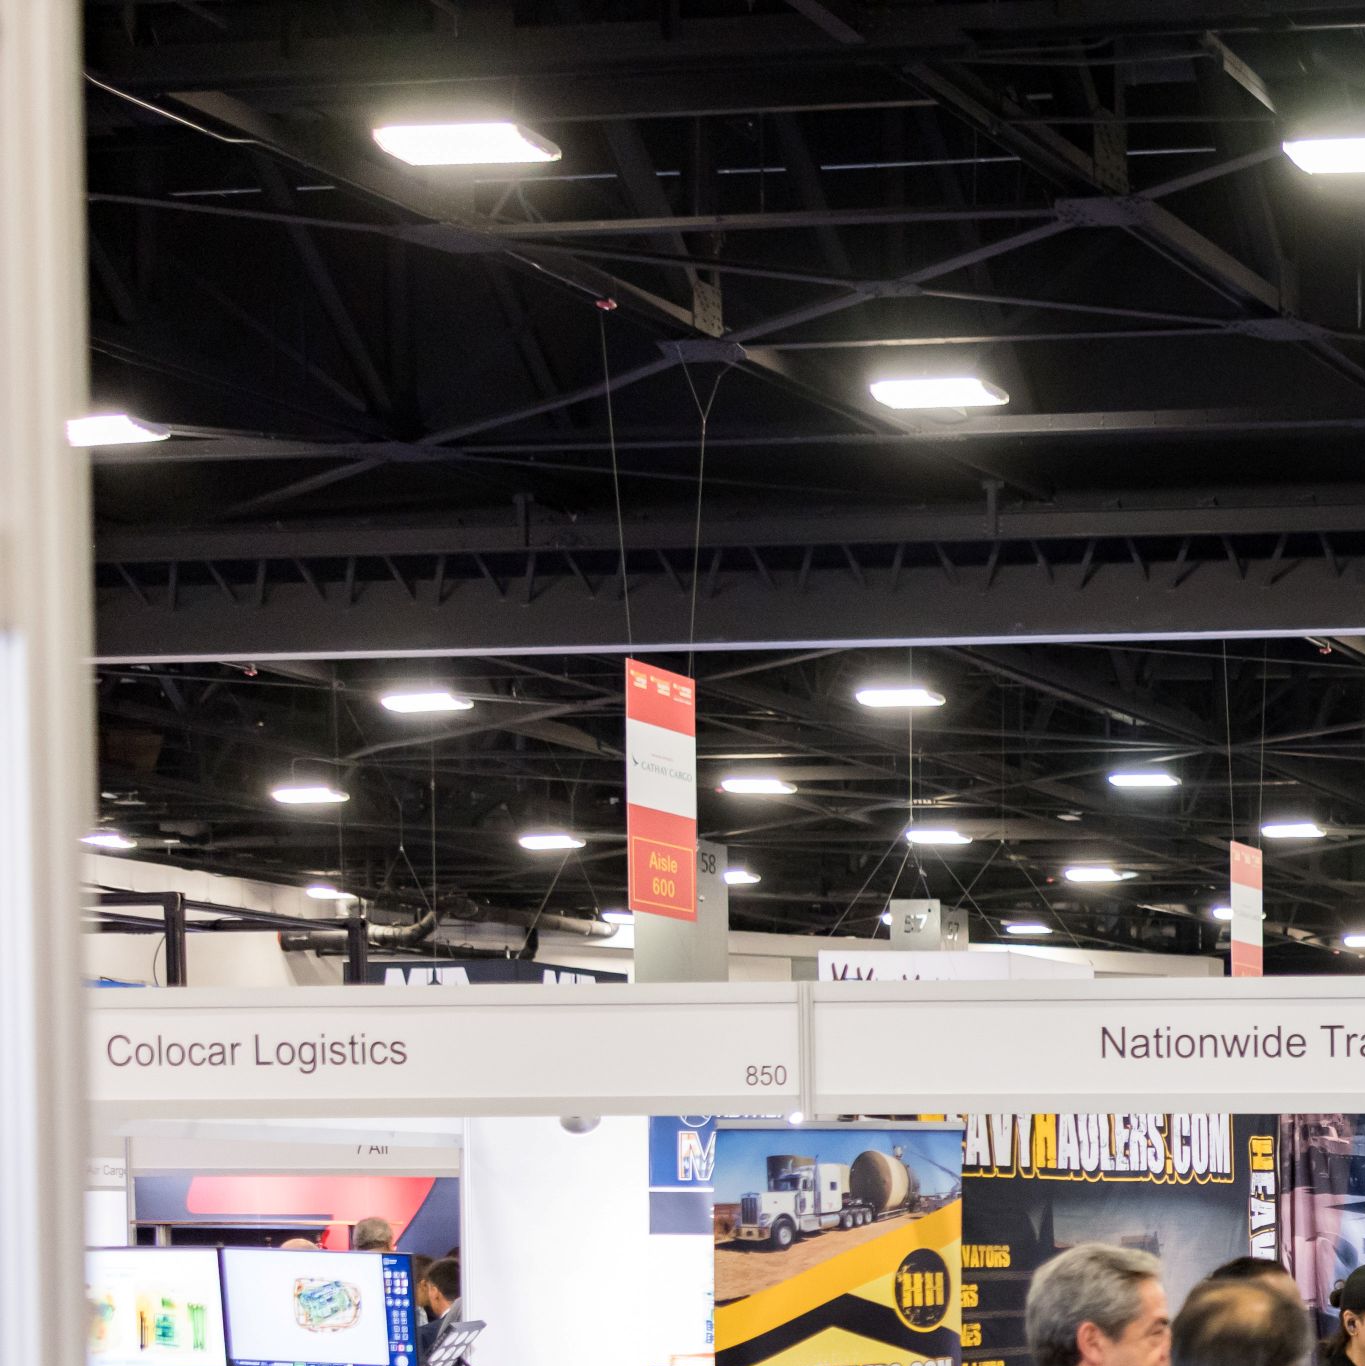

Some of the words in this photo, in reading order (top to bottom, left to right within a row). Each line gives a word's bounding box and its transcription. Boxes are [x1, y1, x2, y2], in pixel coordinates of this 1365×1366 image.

[641, 762, 668, 779] CATHAY
[670, 765, 692, 783] CARGO
[649, 851, 677, 873] Aisle
[701, 852, 716, 874] 58
[653, 879, 675, 898] 600
[1101, 1025, 1307, 1058] Nationwide
[107, 1034, 242, 1066] Colocar
[255, 1033, 408, 1074] Logistics
[746, 1065, 787, 1086] 850
[902, 1272, 944, 1308] HH
